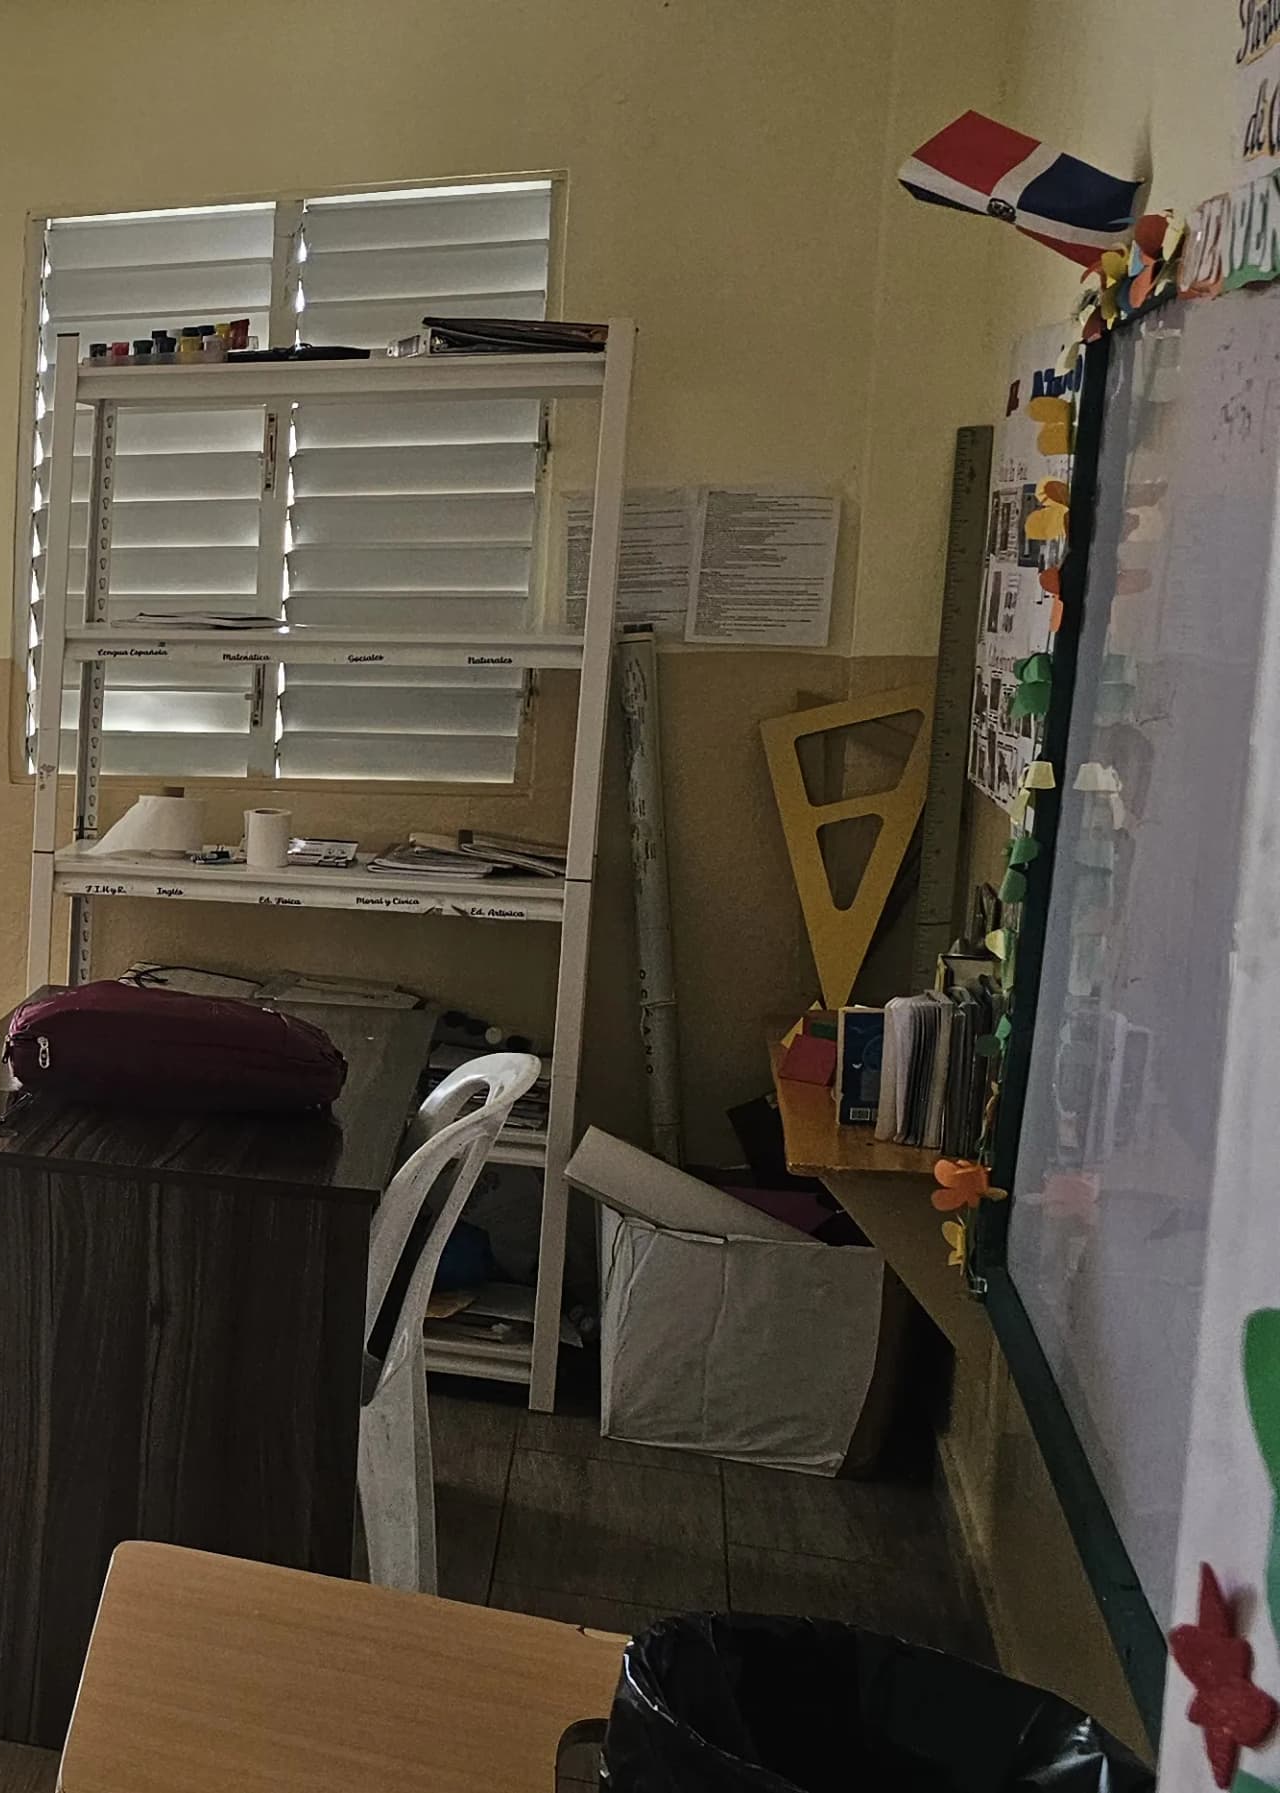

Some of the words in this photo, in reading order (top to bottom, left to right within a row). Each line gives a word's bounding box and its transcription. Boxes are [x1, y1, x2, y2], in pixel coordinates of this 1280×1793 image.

[97, 648, 128, 658] Lengua
[222, 653, 271, 661] Matemática
[347, 654, 385, 663] Sociales
[467, 656, 513, 665] Naturales
[156, 887, 184, 897] Inglés
[355, 897, 384, 905] Moral
[470, 907, 485, 917] Ed.
